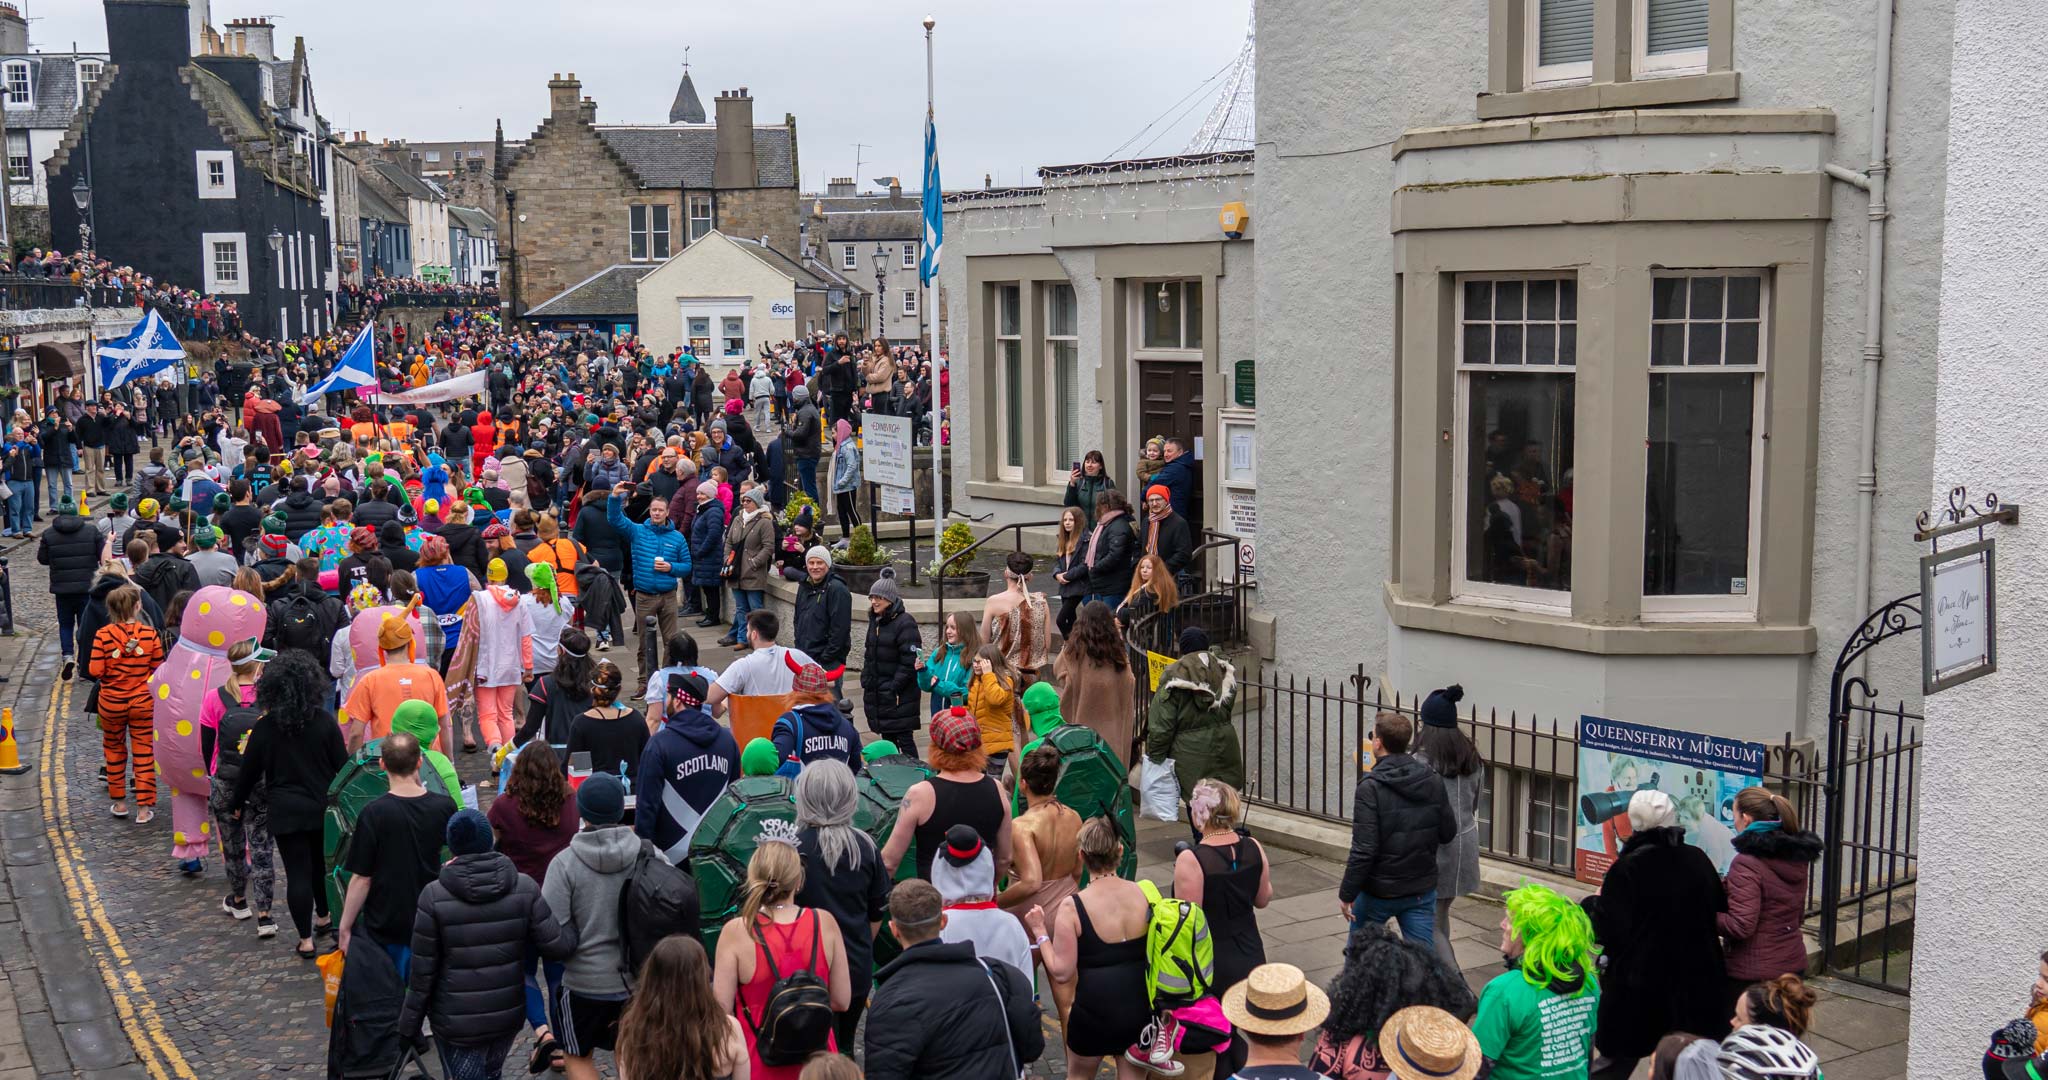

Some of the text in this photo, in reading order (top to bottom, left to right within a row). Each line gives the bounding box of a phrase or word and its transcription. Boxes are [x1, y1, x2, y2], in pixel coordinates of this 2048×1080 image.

[772, 304, 793, 314] espc
[1938, 596, 1958, 616] Once
[805, 735, 848, 754] SCOTLAND
[1586, 722, 1757, 763] QUEENSFERRY MUSEUM
[676, 754, 729, 780] SCOTLAND
